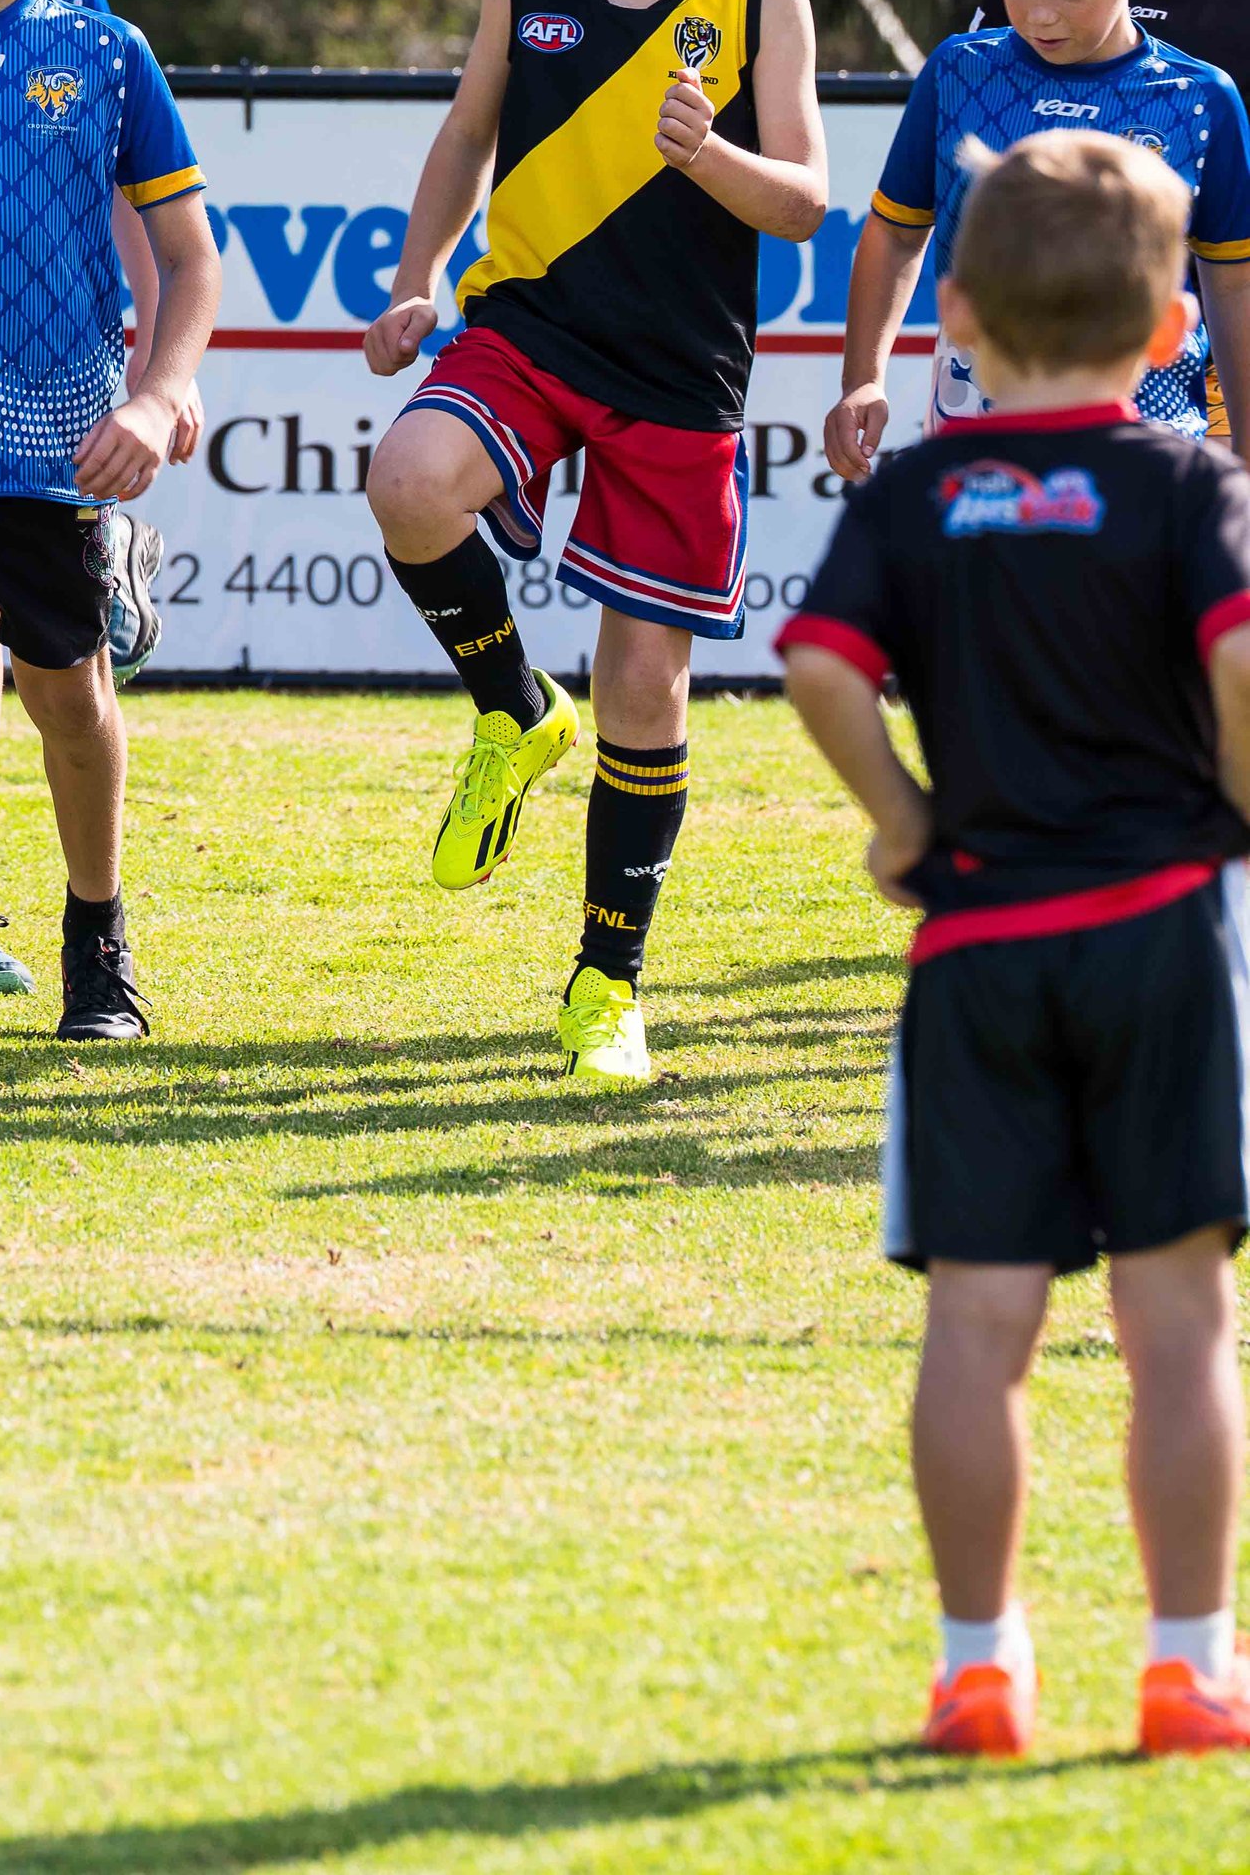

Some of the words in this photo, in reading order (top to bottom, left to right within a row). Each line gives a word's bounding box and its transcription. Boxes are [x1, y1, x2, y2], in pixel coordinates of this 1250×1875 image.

[522, 21, 576, 43] AFL
[207, 414, 376, 496] Chi
[223, 554, 384, 607] 4400
[583, 899, 637, 931] FNL
